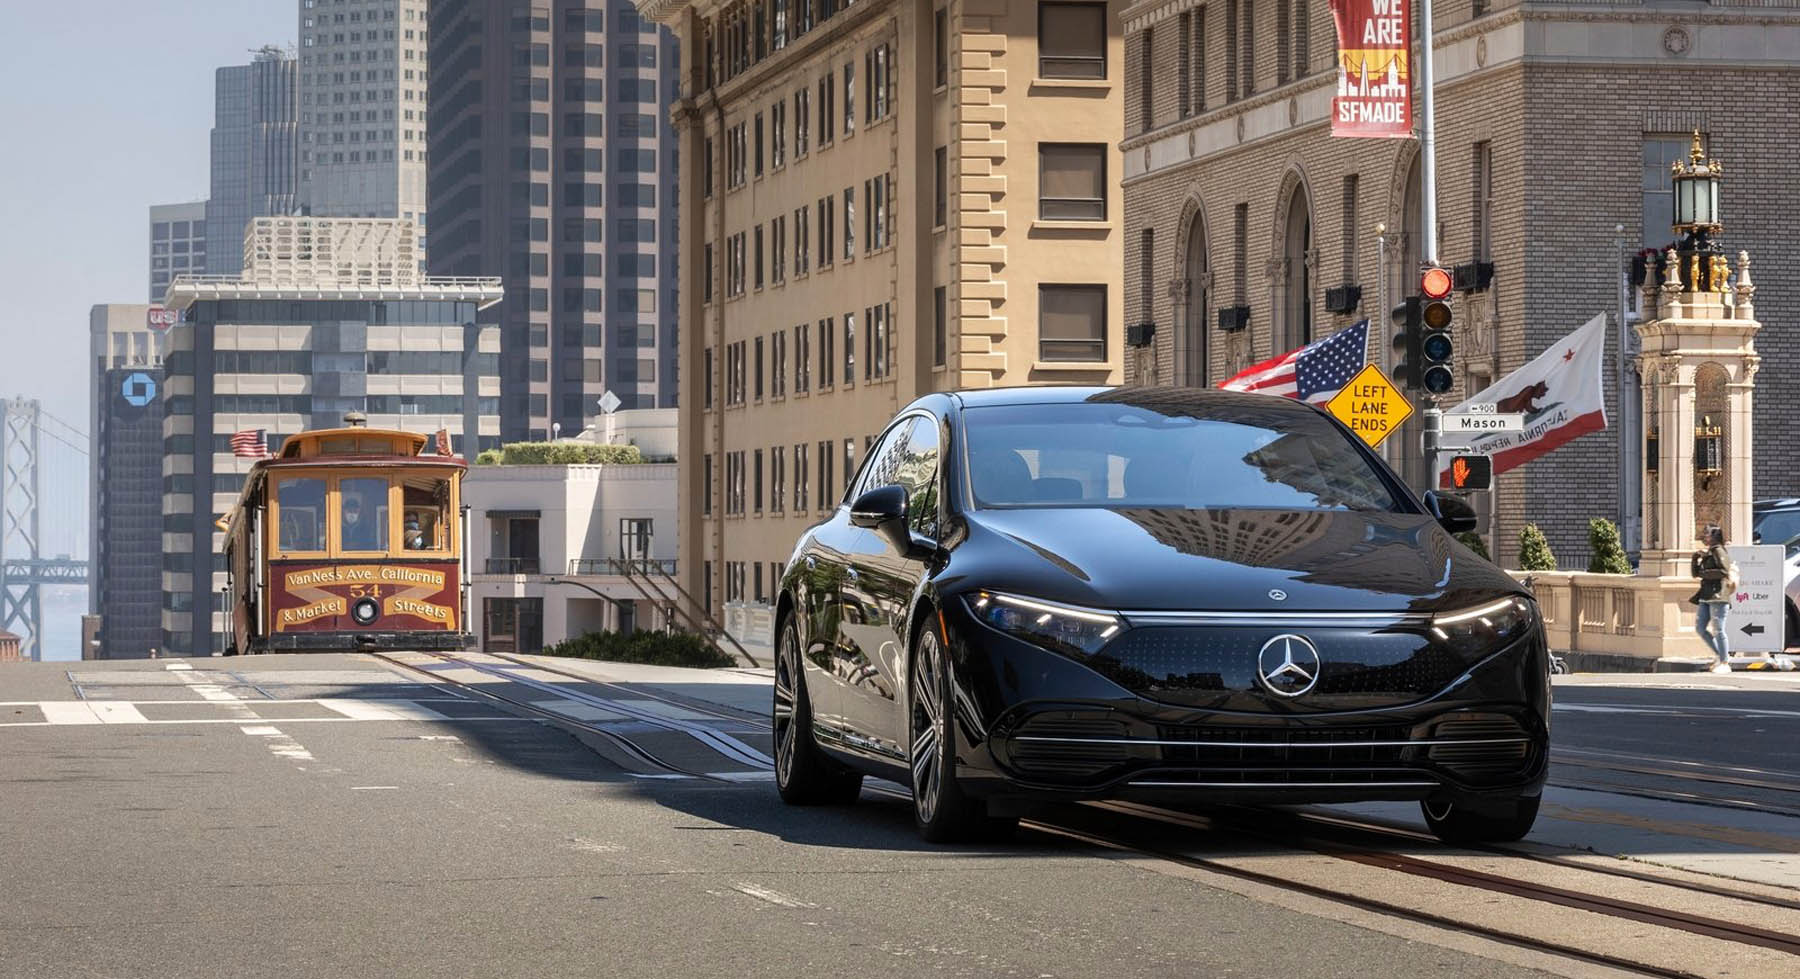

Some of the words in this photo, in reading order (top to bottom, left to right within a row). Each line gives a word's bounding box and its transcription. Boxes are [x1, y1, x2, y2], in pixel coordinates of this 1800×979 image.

[1372, 0, 1403, 16] WE
[1362, 18, 1403, 44] ARE
[1338, 101, 1405, 123] SFMADE
[1354, 385, 1387, 398] LEFT
[1351, 402, 1388, 415] LANE
[1478, 404, 1495, 413] 900
[1351, 418, 1388, 431] ENDS
[1461, 418, 1506, 428] Mason
[381, 567, 443, 585] California
[350, 584, 382, 598] 54
[1752, 592, 1769, 600] Uber
[283, 610, 294, 622] &
[295, 600, 342, 619] Market
[394, 600, 447, 618] Streets
